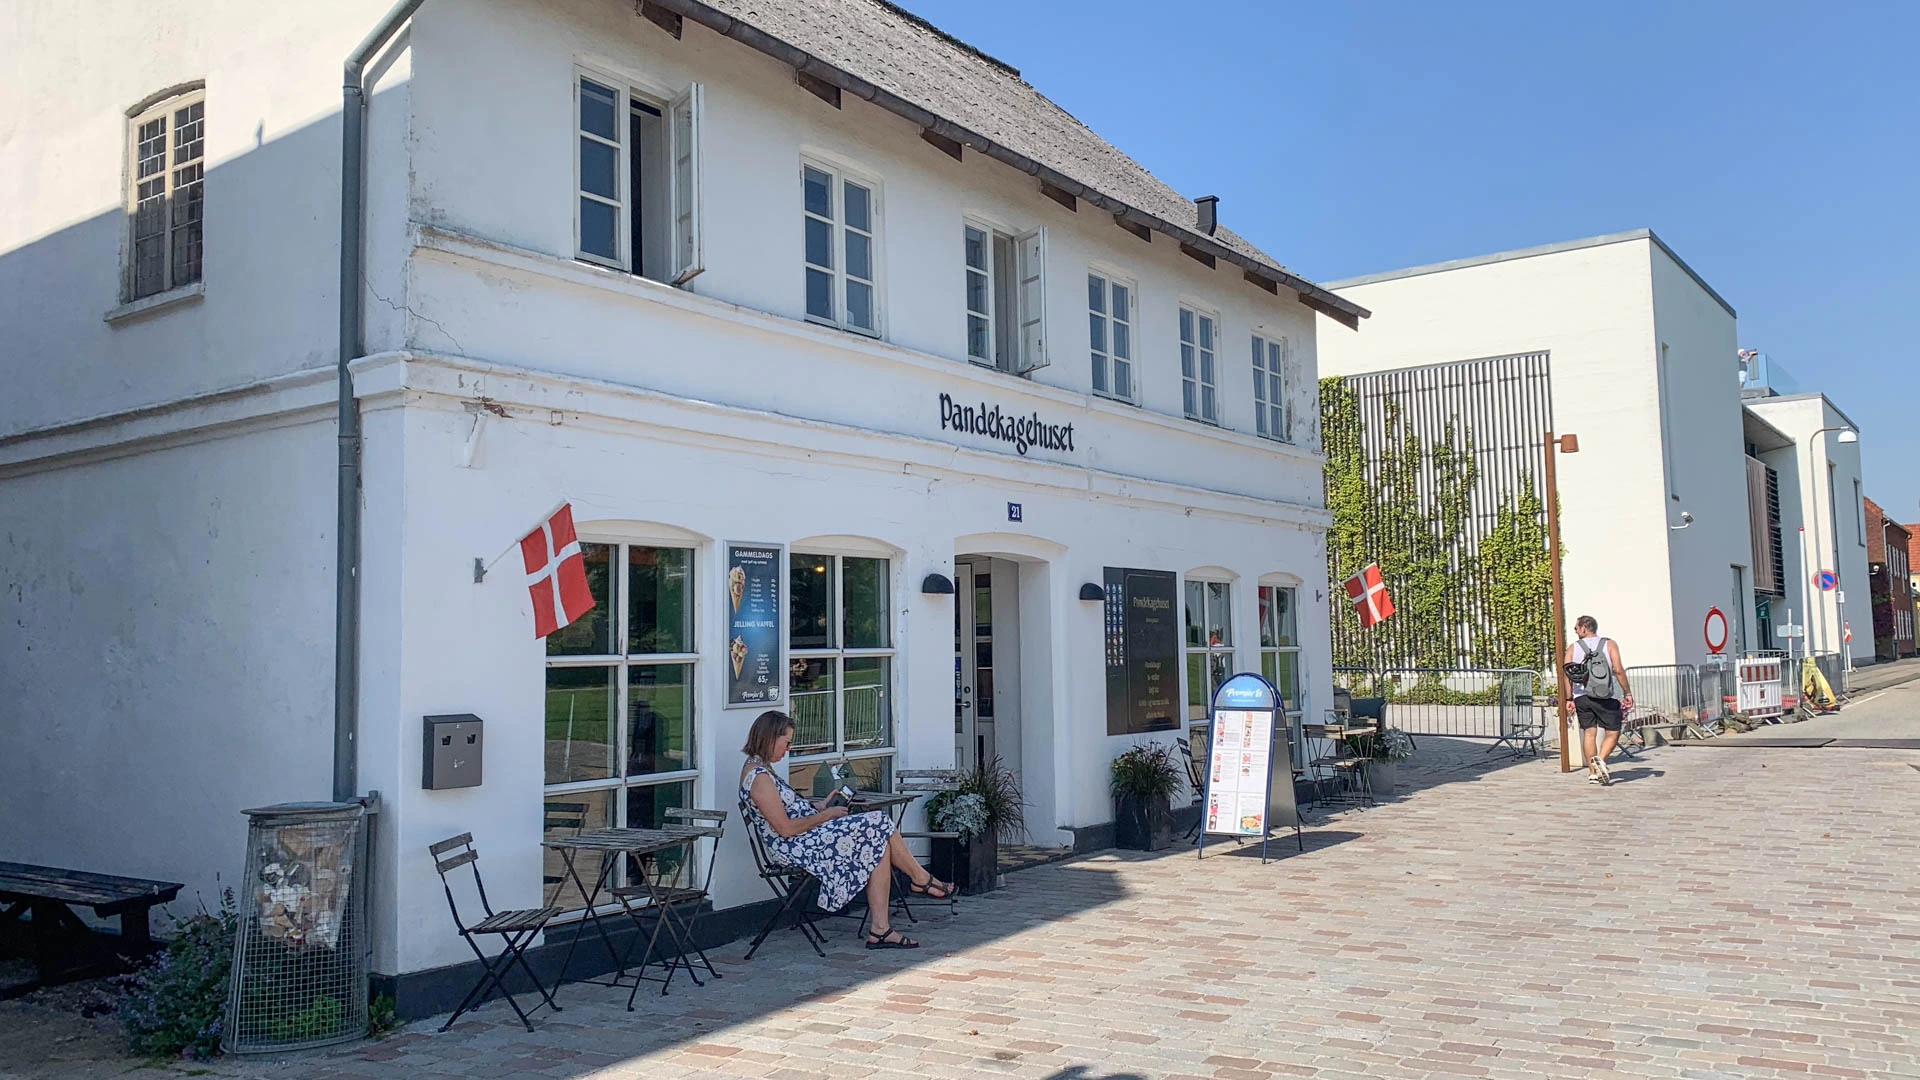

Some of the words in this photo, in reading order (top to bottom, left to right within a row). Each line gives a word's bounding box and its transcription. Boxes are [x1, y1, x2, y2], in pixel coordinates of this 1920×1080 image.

[939, 392, 1075, 455] Pandekagehuset
[1011, 505, 1020, 518] 21
[734, 550, 773, 559] GAMMELDAGS
[733, 620, 755, 628] JELLING
[756, 620, 775, 628] VAFFEL
[757, 675, 769, 684] 65,-
